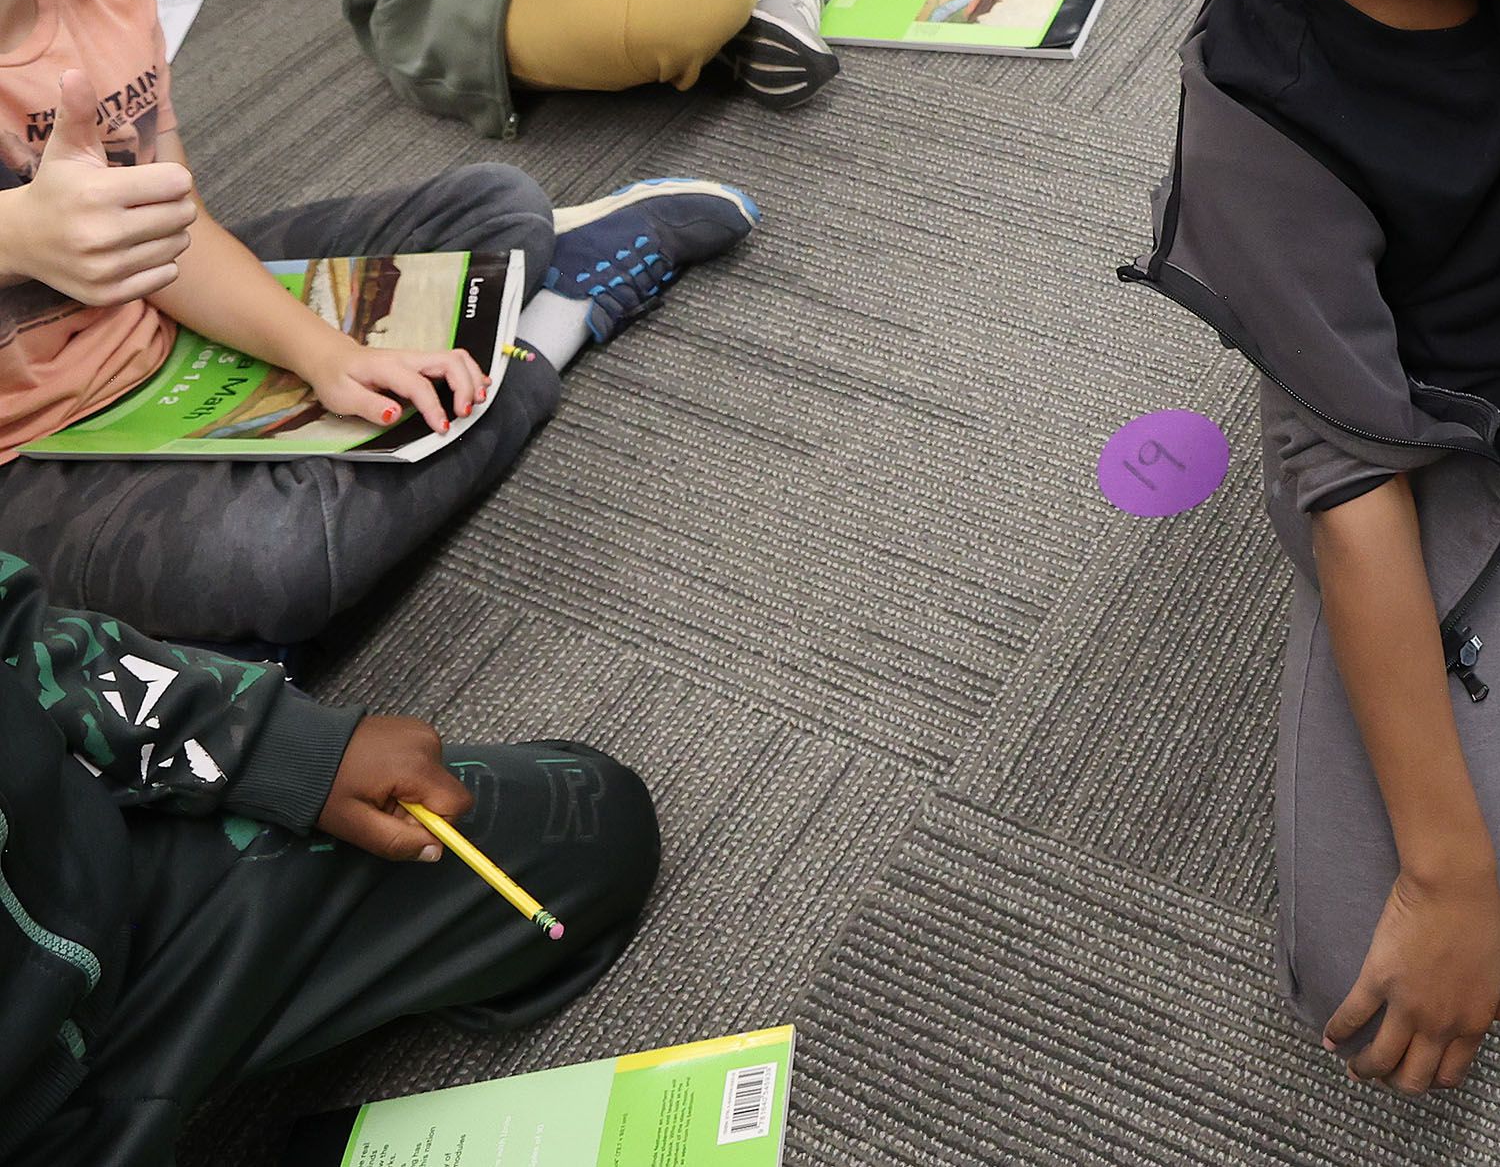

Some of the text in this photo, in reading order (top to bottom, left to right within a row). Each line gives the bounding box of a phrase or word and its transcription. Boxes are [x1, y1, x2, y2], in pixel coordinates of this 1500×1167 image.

[26, 108, 57, 123] TH
[465, 277, 485, 319] Learn
[157, 396, 180, 405] 2
[181, 377, 249, 420] Math
[1122, 439, 1187, 491] 19
